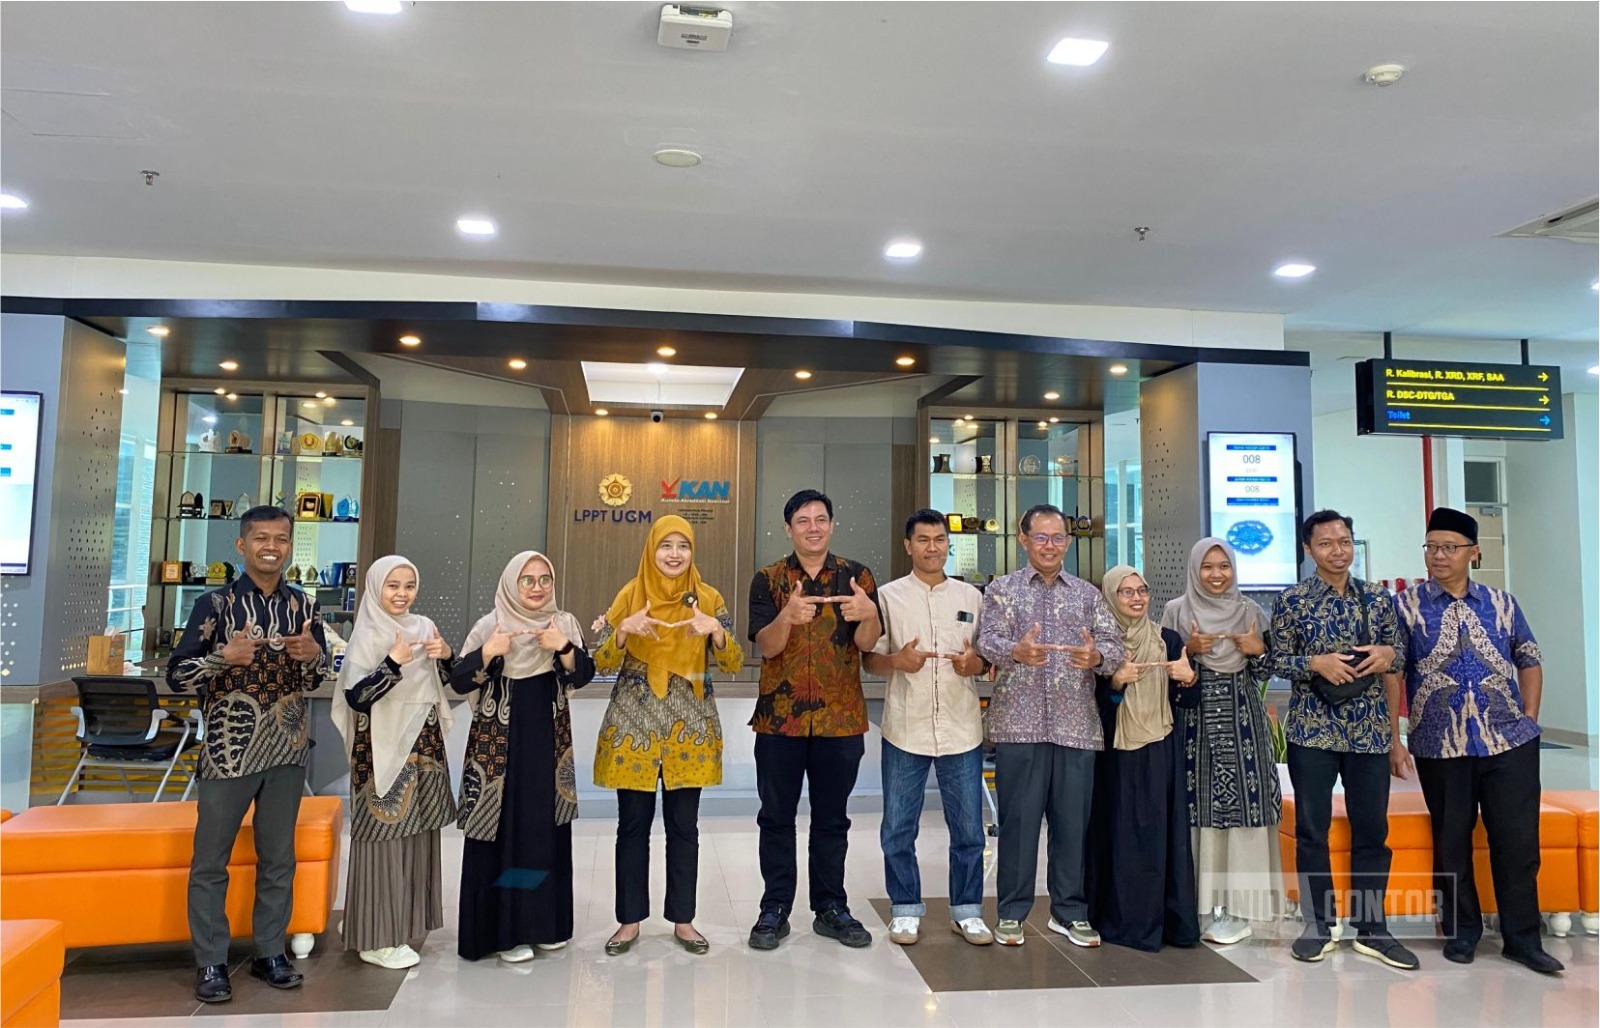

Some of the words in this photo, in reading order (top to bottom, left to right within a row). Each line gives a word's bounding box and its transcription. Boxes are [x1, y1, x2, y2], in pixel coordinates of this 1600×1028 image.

[1386, 368, 1395, 377] R.
[1396, 369, 1433, 380] Kalibrasi,
[1434, 371, 1444, 379] R.
[1445, 371, 1466, 381] XRD,
[1467, 372, 1486, 382] XRF,
[1487, 372, 1505, 382] SAA
[1386, 390, 1396, 399] R.
[1397, 390, 1455, 401] DSC-DTG/TGA
[1387, 410, 1411, 420] Toilet
[1242, 455, 1261, 464] 008
[678, 480, 731, 498] KAN
[1245, 485, 1260, 493] 008
[574, 509, 608, 522] LPPT
[611, 510, 652, 523] UGM
